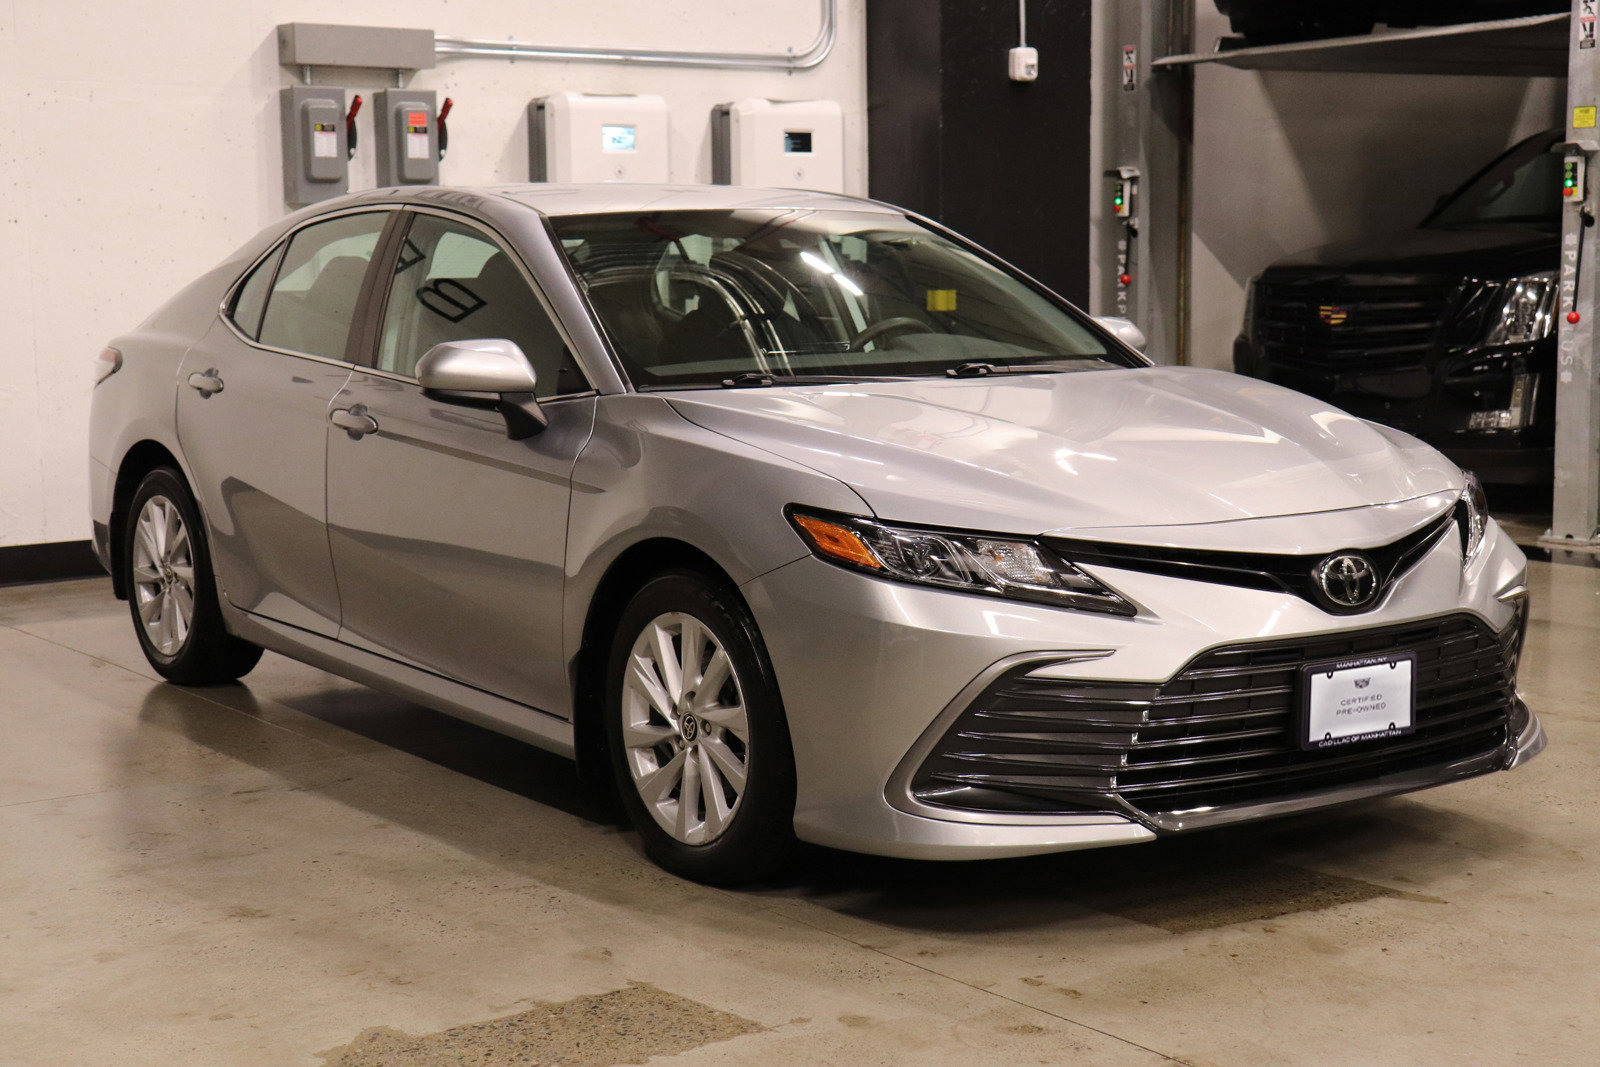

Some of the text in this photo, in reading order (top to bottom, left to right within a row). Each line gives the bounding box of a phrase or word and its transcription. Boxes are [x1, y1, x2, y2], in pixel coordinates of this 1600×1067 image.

[1340, 693, 1382, 706] CERTIFIED
[1336, 702, 1386, 716] PRE-OWNED
[1318, 729, 1402, 748] CADILLAC OF MANHATTAN
